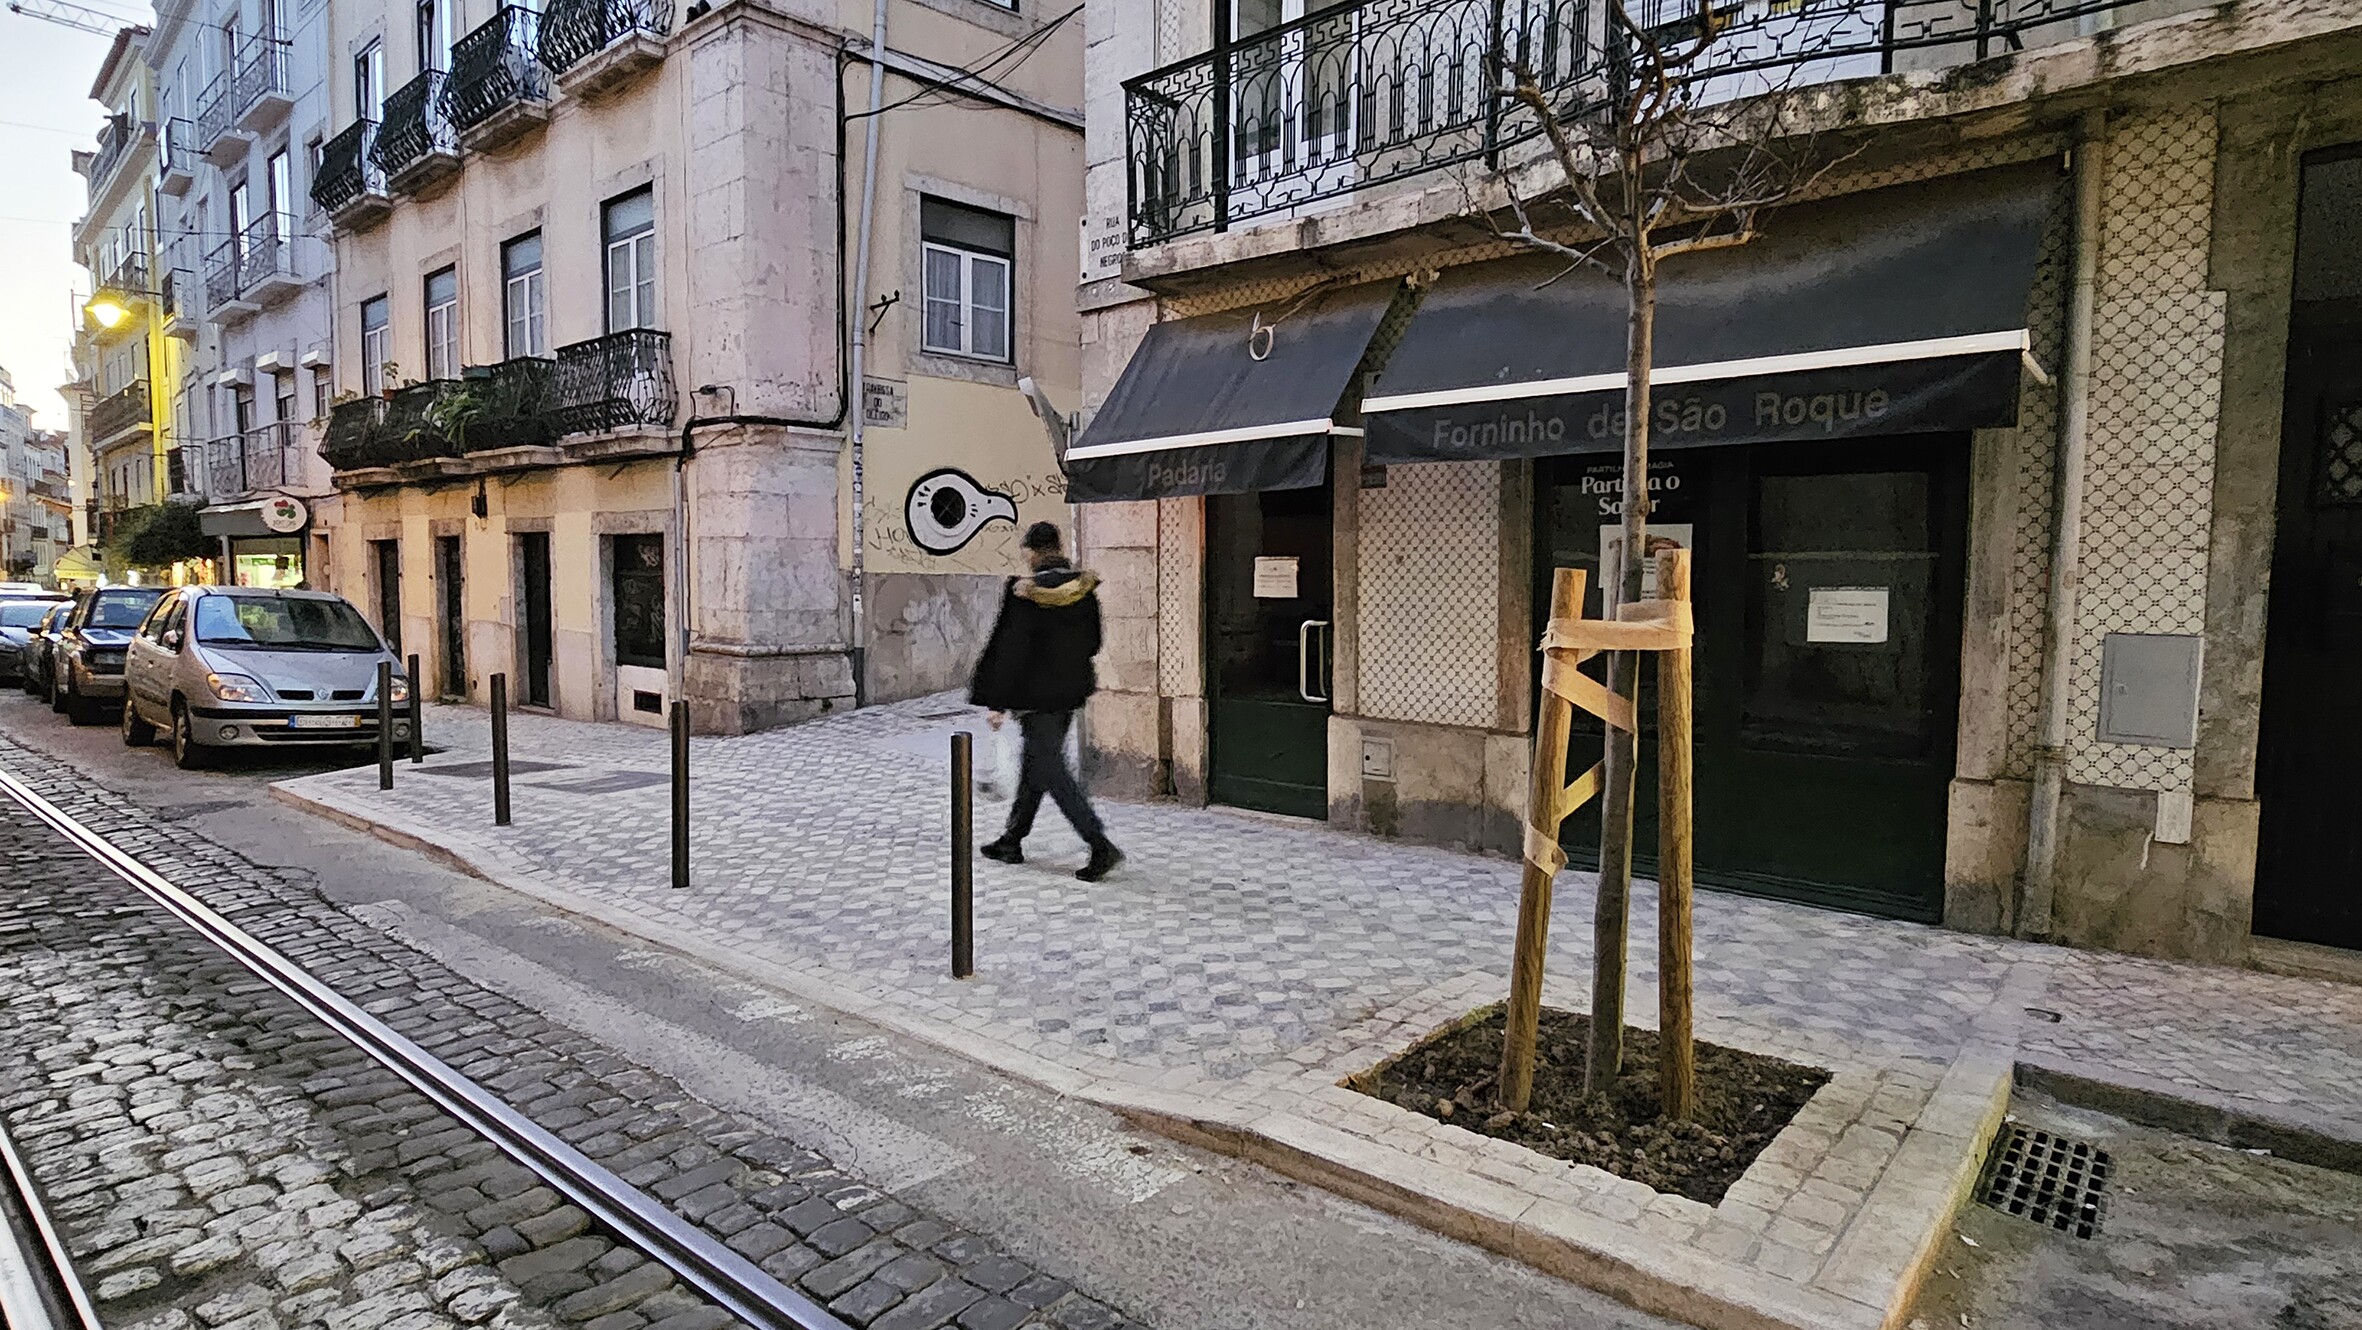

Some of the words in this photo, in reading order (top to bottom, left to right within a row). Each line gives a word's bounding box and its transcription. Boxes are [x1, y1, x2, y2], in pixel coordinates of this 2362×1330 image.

[1106, 217, 1120, 229] RUA
[1091, 239, 1100, 252] DO
[1102, 233, 1120, 249] POÇO
[1100, 252, 1125, 267] NEGRO
[873, 397, 883, 408] DO
[1432, 409, 1566, 449] Forninho
[1588, 403, 1625, 440] de
[1656, 396, 1728, 436] São
[1755, 386, 1890, 433] Roque
[1147, 459, 1227, 488] Padaria
[1581, 476, 1662, 495] Parta
[1665, 475, 1680, 490] o
